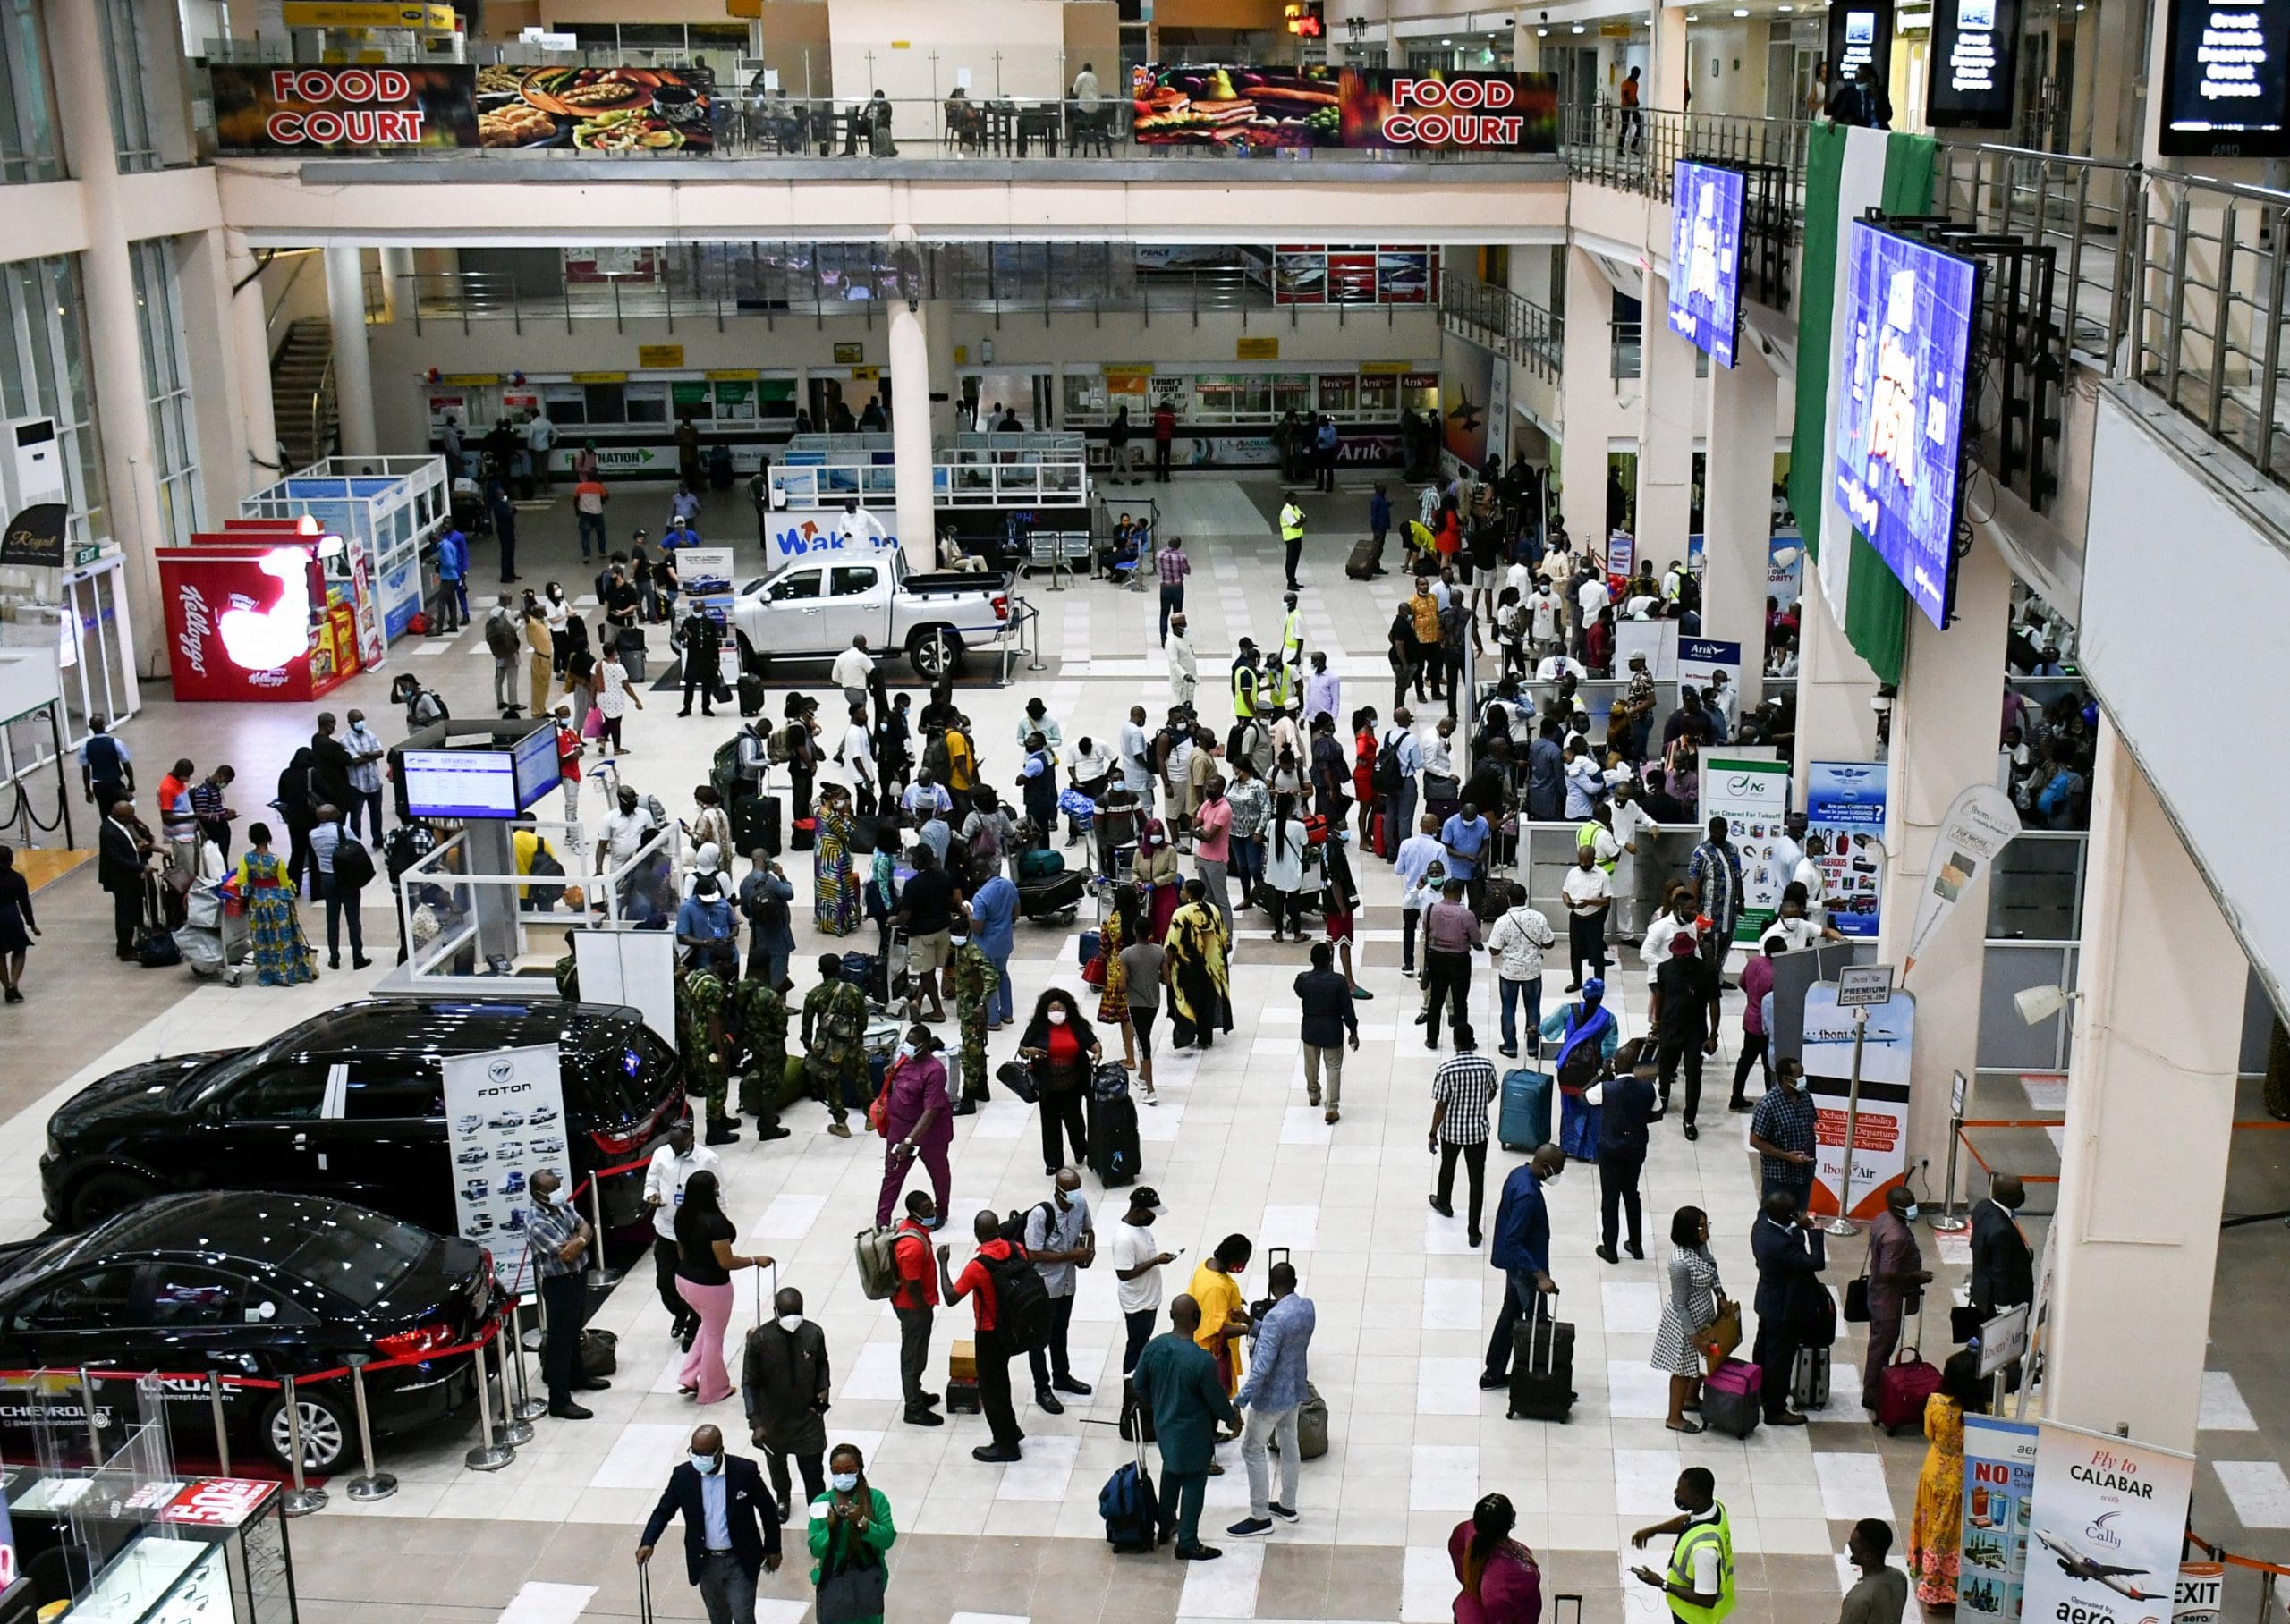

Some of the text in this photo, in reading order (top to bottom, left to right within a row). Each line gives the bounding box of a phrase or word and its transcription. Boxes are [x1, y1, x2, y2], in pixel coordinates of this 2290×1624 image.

[272, 70, 410, 103] FOOD
[1392, 79, 1514, 108] FOOD
[267, 112, 425, 144] COURT
[1382, 115, 1523, 145] COURT
[2211, 144, 2240, 156] AMD
[1320, 378, 1340, 388] Arik
[1361, 378, 1381, 387] Arik
[1403, 377, 1422, 386] Arik
[598, 453, 640, 464] NATION
[1337, 444, 1382, 461] Arik
[80, 548, 97, 562] EXIT
[1691, 644, 1712, 655] Arik
[1968, 833, 1987, 846] MORE
[1844, 986, 1886, 994] PREMIUM
[479, 1083, 531, 1097] FOTON
[1859, 1116, 1893, 1126] reliability
[1854, 1127, 1897, 1138] Departures
[1862, 1140, 1891, 1149] Service
[1858, 1167, 1876, 1179] Air
[2091, 1451, 2137, 1474] Fly to
[1975, 1462, 2009, 1484] NO
[2070, 1465, 2153, 1500] CALABAR
[2100, 1493, 2120, 1503] with
[2086, 1527, 2121, 1548] Cally
[2174, 1583, 2220, 1603] EXIT
[2071, 1596, 2105, 1611] Operated
[2182, 1615, 2209, 1623] aero
